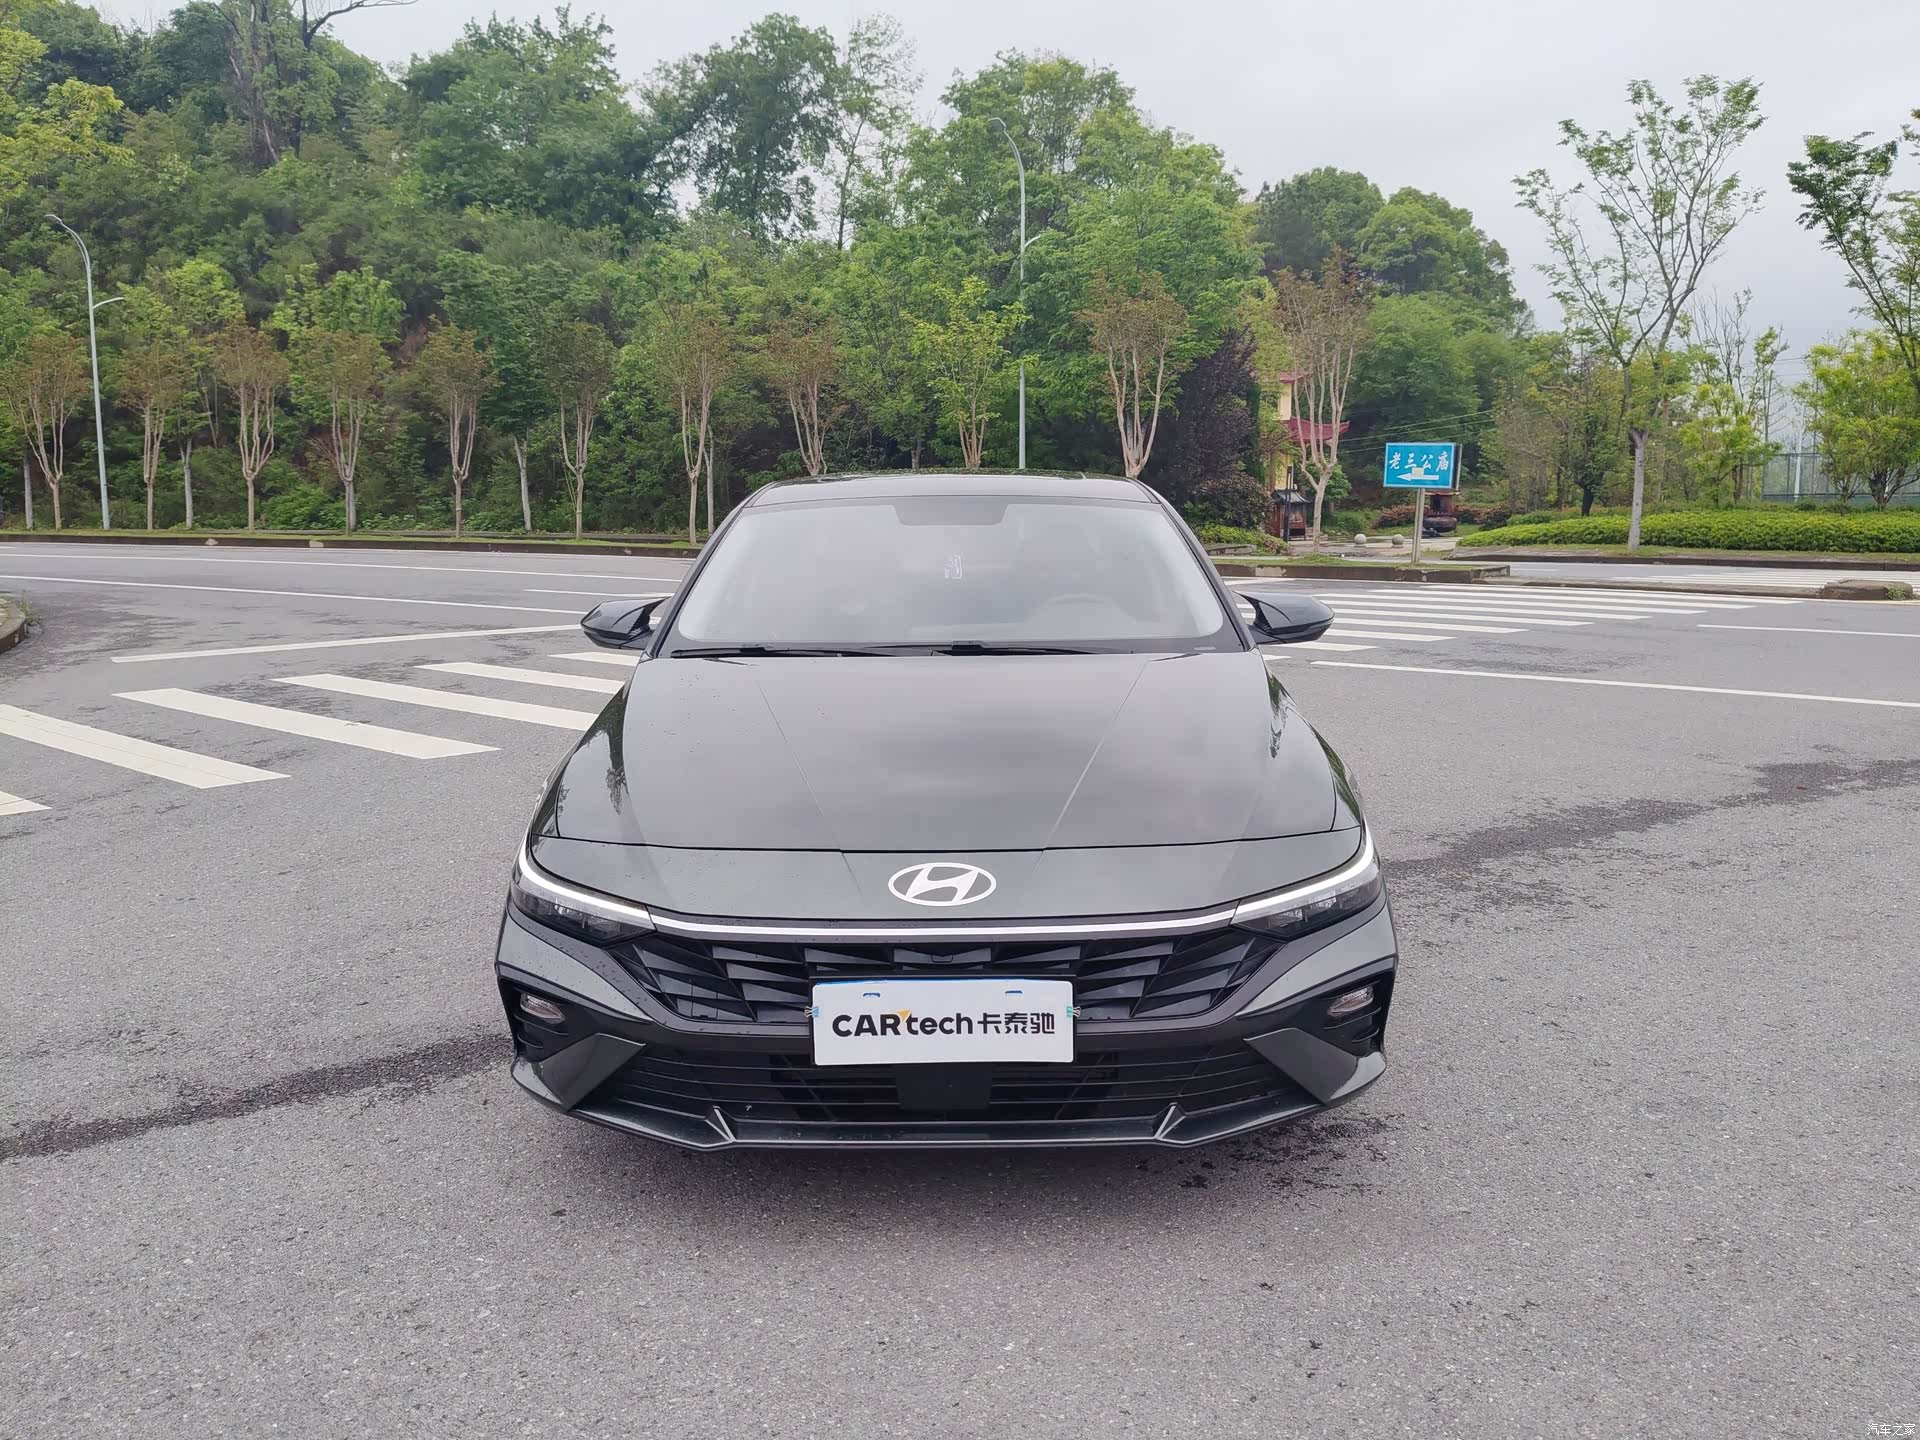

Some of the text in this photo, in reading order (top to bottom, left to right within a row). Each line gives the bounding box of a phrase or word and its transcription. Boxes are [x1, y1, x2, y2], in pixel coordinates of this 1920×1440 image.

[832, 1010, 1056, 1037] CARtech 卡泰驰
